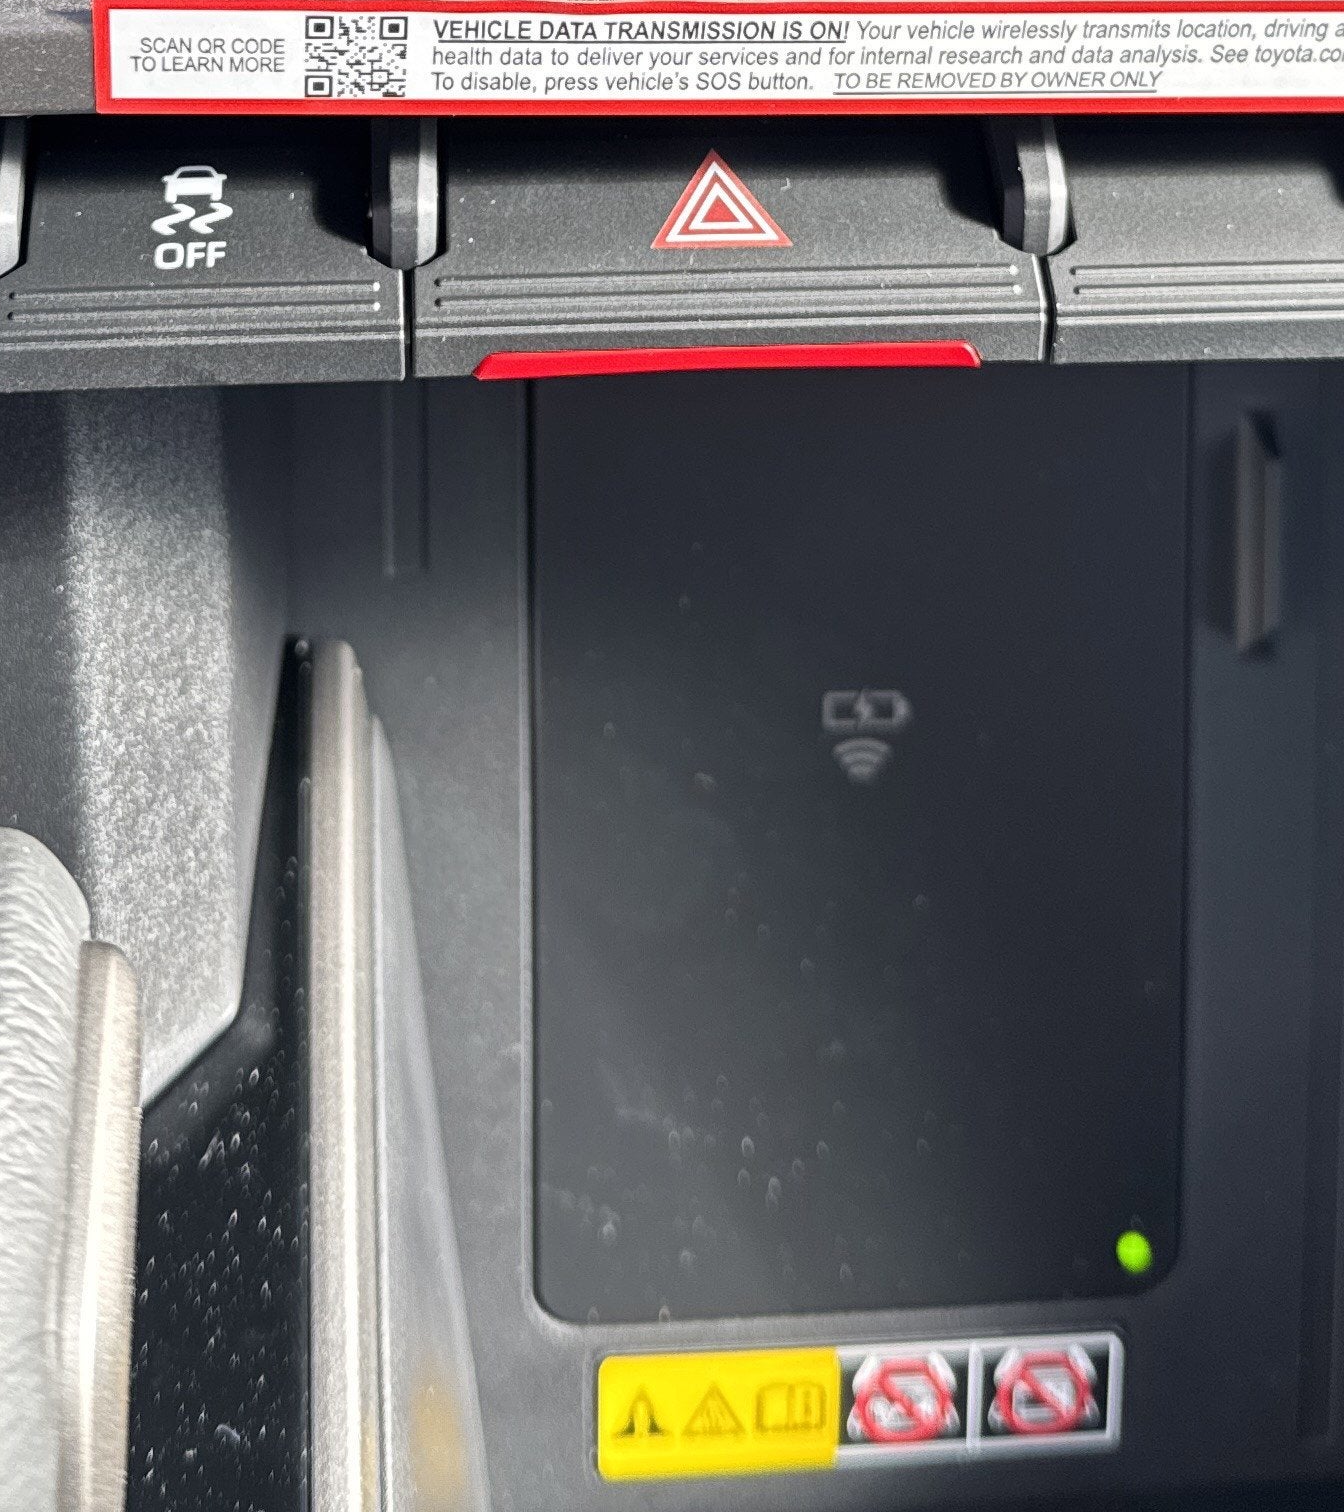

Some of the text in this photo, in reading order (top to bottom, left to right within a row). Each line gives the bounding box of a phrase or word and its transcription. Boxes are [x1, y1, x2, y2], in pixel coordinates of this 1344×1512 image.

[433, 20, 532, 39] VEHICLE
[540, 21, 597, 39] DATA
[604, 21, 776, 40] TRANSMISSION
[783, 21, 803, 40] IS
[810, 21, 850, 40] ON!
[857, 21, 901, 40] Your
[907, 20, 975, 39] vehicle
[981, 20, 1077, 43] wirelessly
[1082, 20, 1170, 39] transmits
[1176, 19, 1258, 41] location,
[1264, 19, 1329, 42] driving
[140, 37, 285, 54] SCAN QR CODE
[432, 46, 493, 65] health
[500, 47, 542, 66] data
[551, 48, 569, 65] to
[577, 47, 643, 65] deliver
[648, 51, 693, 70] your
[698, 48, 779, 65] services
[785, 47, 822, 65] and
[828, 47, 855, 66] for
[860, 46, 933, 65] internal
[938, 45, 1023, 65] research
[1029, 45, 1067, 65] and
[1071, 45, 1114, 64] data
[1119, 45, 1203, 67] analysis.
[1210, 44, 1248, 63] See
[130, 56, 285, 72] TO LEARN MORE
[431, 72, 454, 91] To
[461, 72, 537, 93] disable,
[544, 75, 598, 95] press
[696, 72, 741, 90] SOS
[748, 72, 813, 90] button.
[834, 72, 861, 89] TO
[866, 72, 892, 88] BE
[897, 72, 996, 88] REMOVED
[1001, 72, 1027, 88] BY
[1031, 71, 1106, 88] OWNER
[1110, 70, 1163, 87] ONLY
[153, 240, 227, 270] OFF
